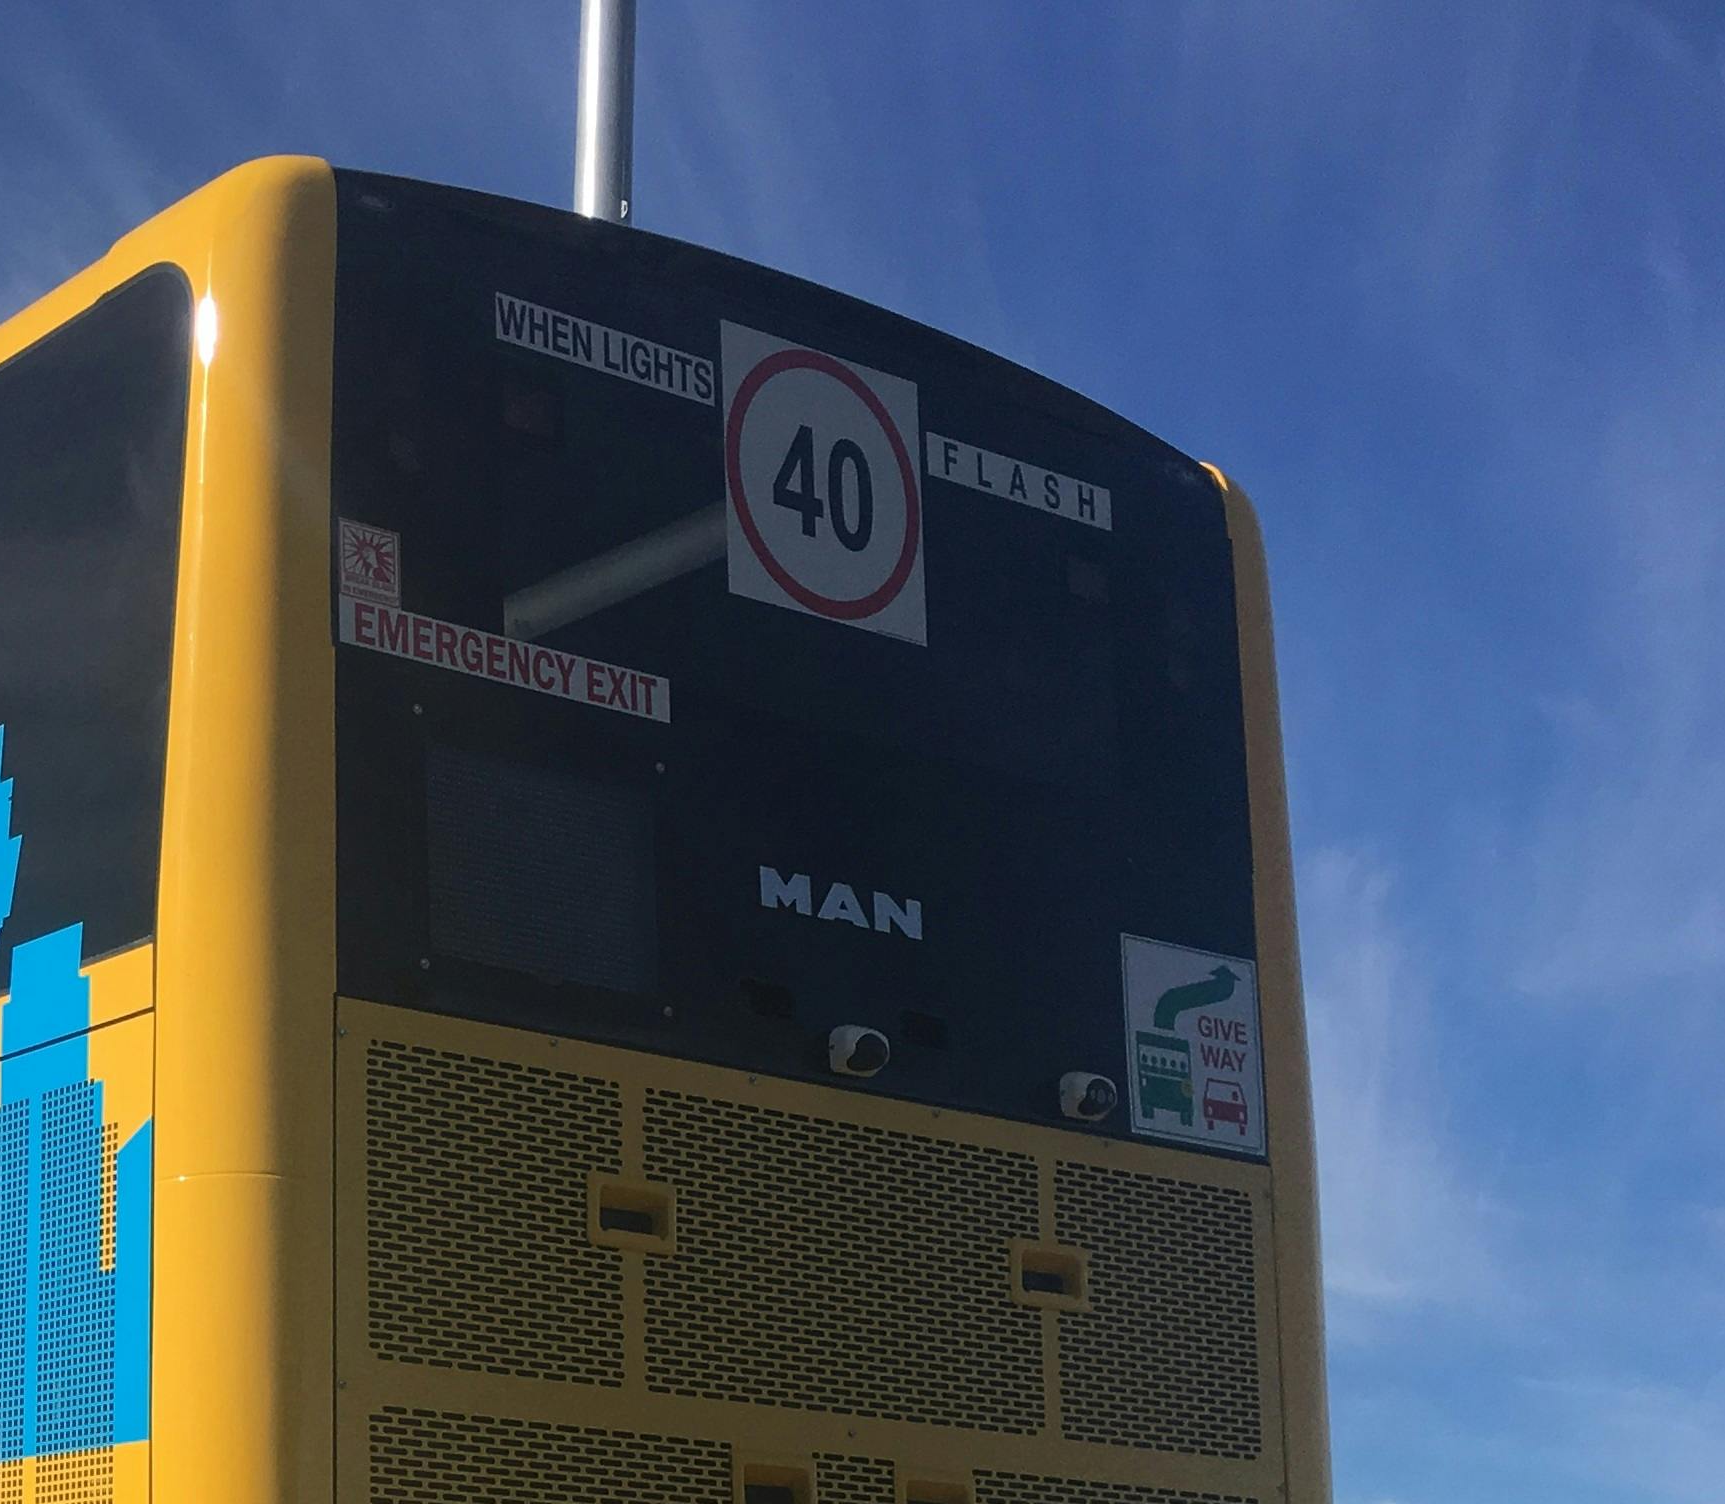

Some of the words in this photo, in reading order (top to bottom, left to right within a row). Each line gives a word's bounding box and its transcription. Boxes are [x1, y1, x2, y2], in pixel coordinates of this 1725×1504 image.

[497, 298, 592, 363] WHEN
[604, 328, 714, 400] LIGHTS
[772, 424, 875, 553] 40
[942, 441, 1098, 523] FLASH
[353, 602, 576, 698] EMERGENCY
[585, 660, 658, 718] EXIT
[758, 865, 923, 940] MAN
[1197, 1014, 1248, 1046] GIVE
[1199, 1042, 1247, 1073] WAY
